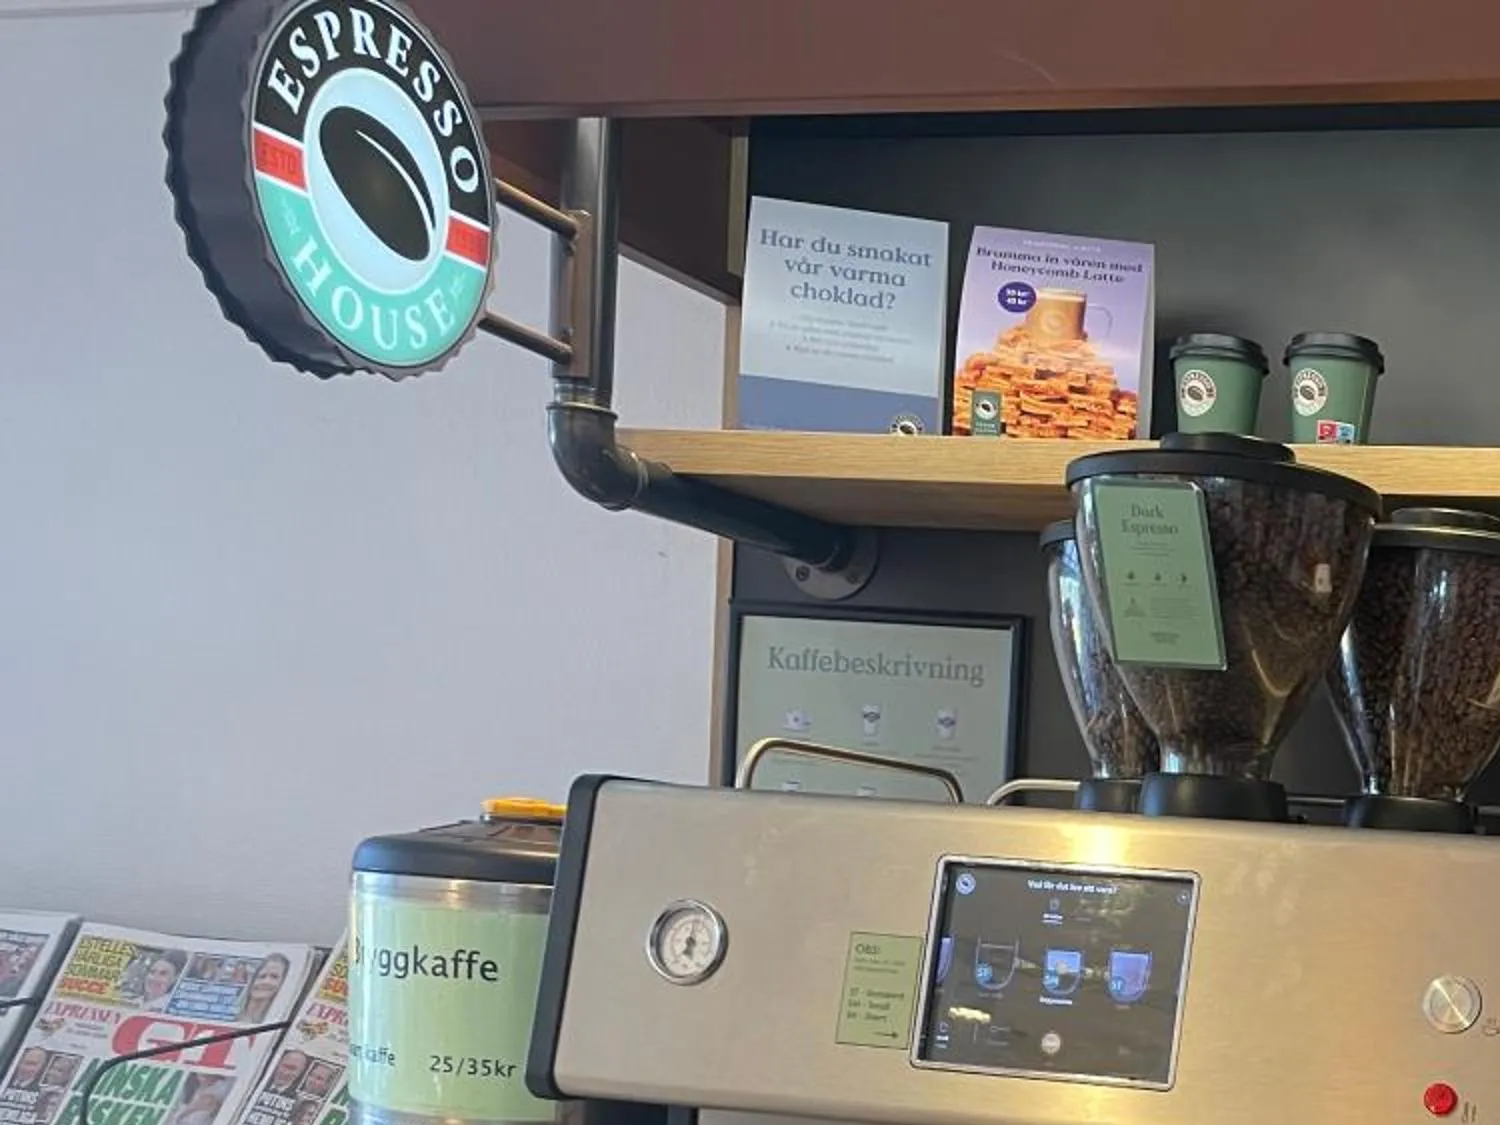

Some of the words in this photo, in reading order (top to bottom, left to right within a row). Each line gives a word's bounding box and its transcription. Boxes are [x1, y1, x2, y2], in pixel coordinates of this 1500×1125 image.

[266, 8, 480, 193] ESPRESSO
[759, 227, 804, 250] Har
[811, 236, 841, 256] du
[847, 245, 934, 268] smakat
[785, 256, 823, 276] vår
[830, 264, 906, 287] varma
[291, 237, 456, 350] HOUSE
[790, 281, 896, 310] choklad?
[1130, 502, 1165, 519] Dark
[767, 646, 984, 688] Kaffebeskrivning
[355, 935, 499, 981] Byggkaffe
[430, 1055, 519, 1078] 25/35kr
